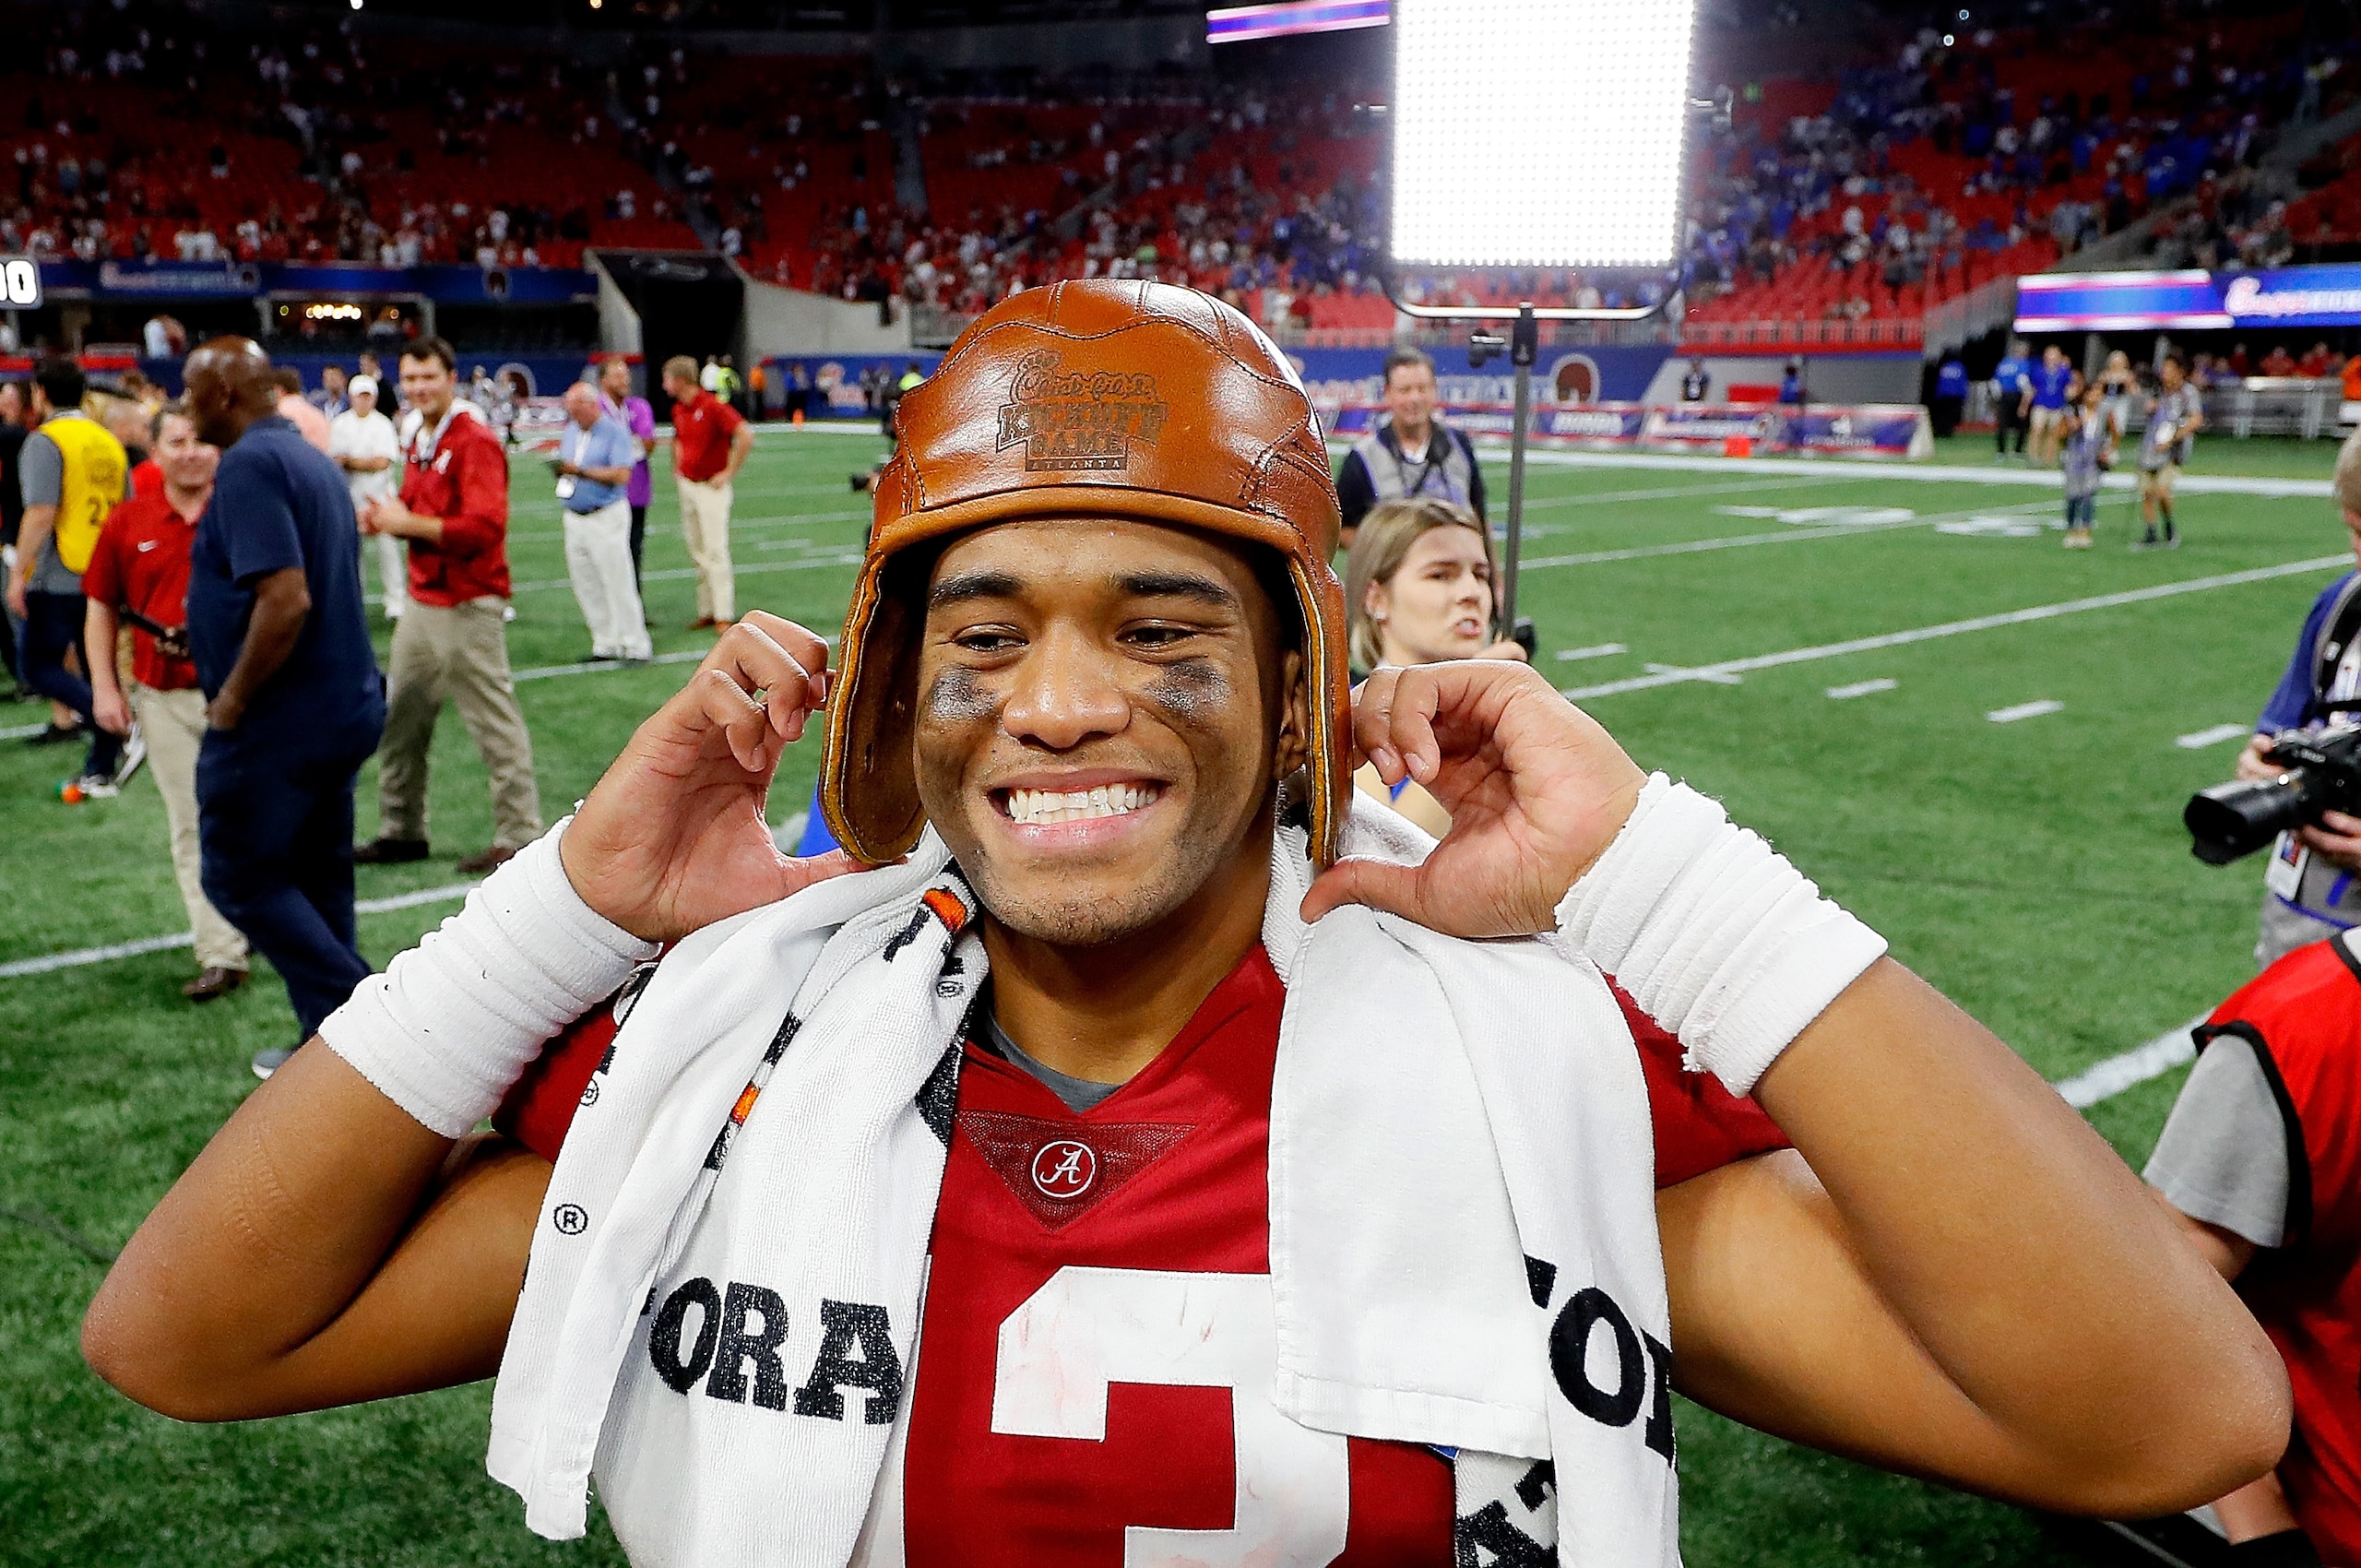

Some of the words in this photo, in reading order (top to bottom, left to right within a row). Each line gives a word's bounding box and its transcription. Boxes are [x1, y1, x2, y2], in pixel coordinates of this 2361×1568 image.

[0, 259, 37, 304] 0
[1030, 432, 1124, 457] GAME
[1031, 460, 1121, 469] ATLANTA
[640, 1277, 903, 1424] ORA
